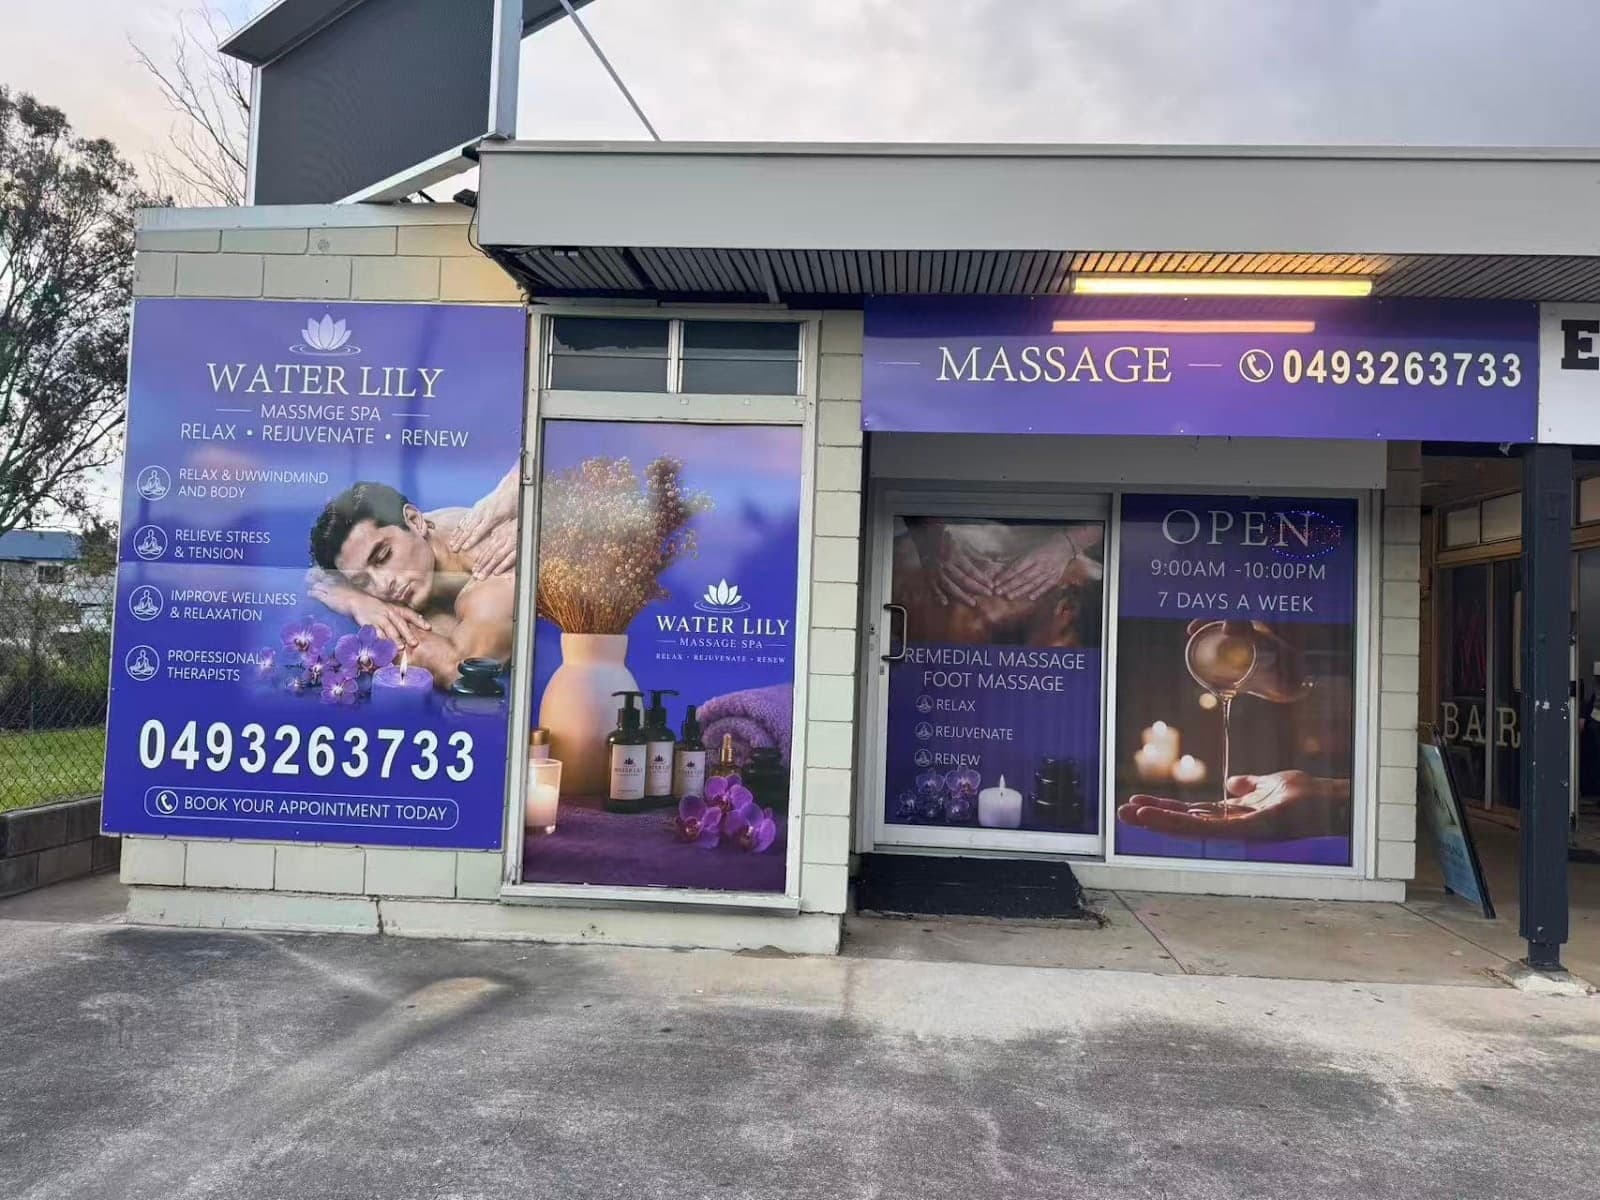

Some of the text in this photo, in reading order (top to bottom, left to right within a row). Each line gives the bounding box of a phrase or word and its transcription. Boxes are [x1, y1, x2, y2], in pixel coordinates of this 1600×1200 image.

[937, 346, 1523, 388] MASSAGE 0493263733
[207, 363, 444, 399] WATER LILY
[260, 404, 382, 422] MASSMGE SPA
[180, 423, 469, 448] RELAX REJUVENATE RENEW
[179, 468, 218, 481] RELAX
[221, 469, 231, 481] &
[178, 485, 247, 499] AND BODY
[175, 529, 271, 544] RELIEVE STRESS
[1162, 509, 1311, 547] OPEN
[174, 546, 244, 560] & TENSION
[1150, 560, 1225, 577] 9:00AM
[171, 590, 297, 606] IMPROVE WELLNESS
[1158, 592, 1314, 613] 7 DAYS A WEEK
[169, 606, 262, 621] & RELAXATION
[656, 615, 789, 636] WATER LILY
[679, 637, 763, 649] MASSAGE SPA
[167, 649, 263, 666] PROFESSIONAL
[693, 654, 747, 663] REJUVENATE
[757, 656, 786, 664] RENEW
[904, 648, 1086, 671] REMEDIAL MASSAGE
[167, 666, 240, 682] THERAPISTS
[923, 671, 1065, 692] FOOT MASSAGE
[936, 699, 976, 712] RELAX
[935, 726, 1014, 741] REJUVENATE
[138, 719, 475, 782] 0493263733
[934, 752, 981, 766] RENEW
[183, 796, 448, 821] BOOK YOUR APPOINTMENT TODAY
